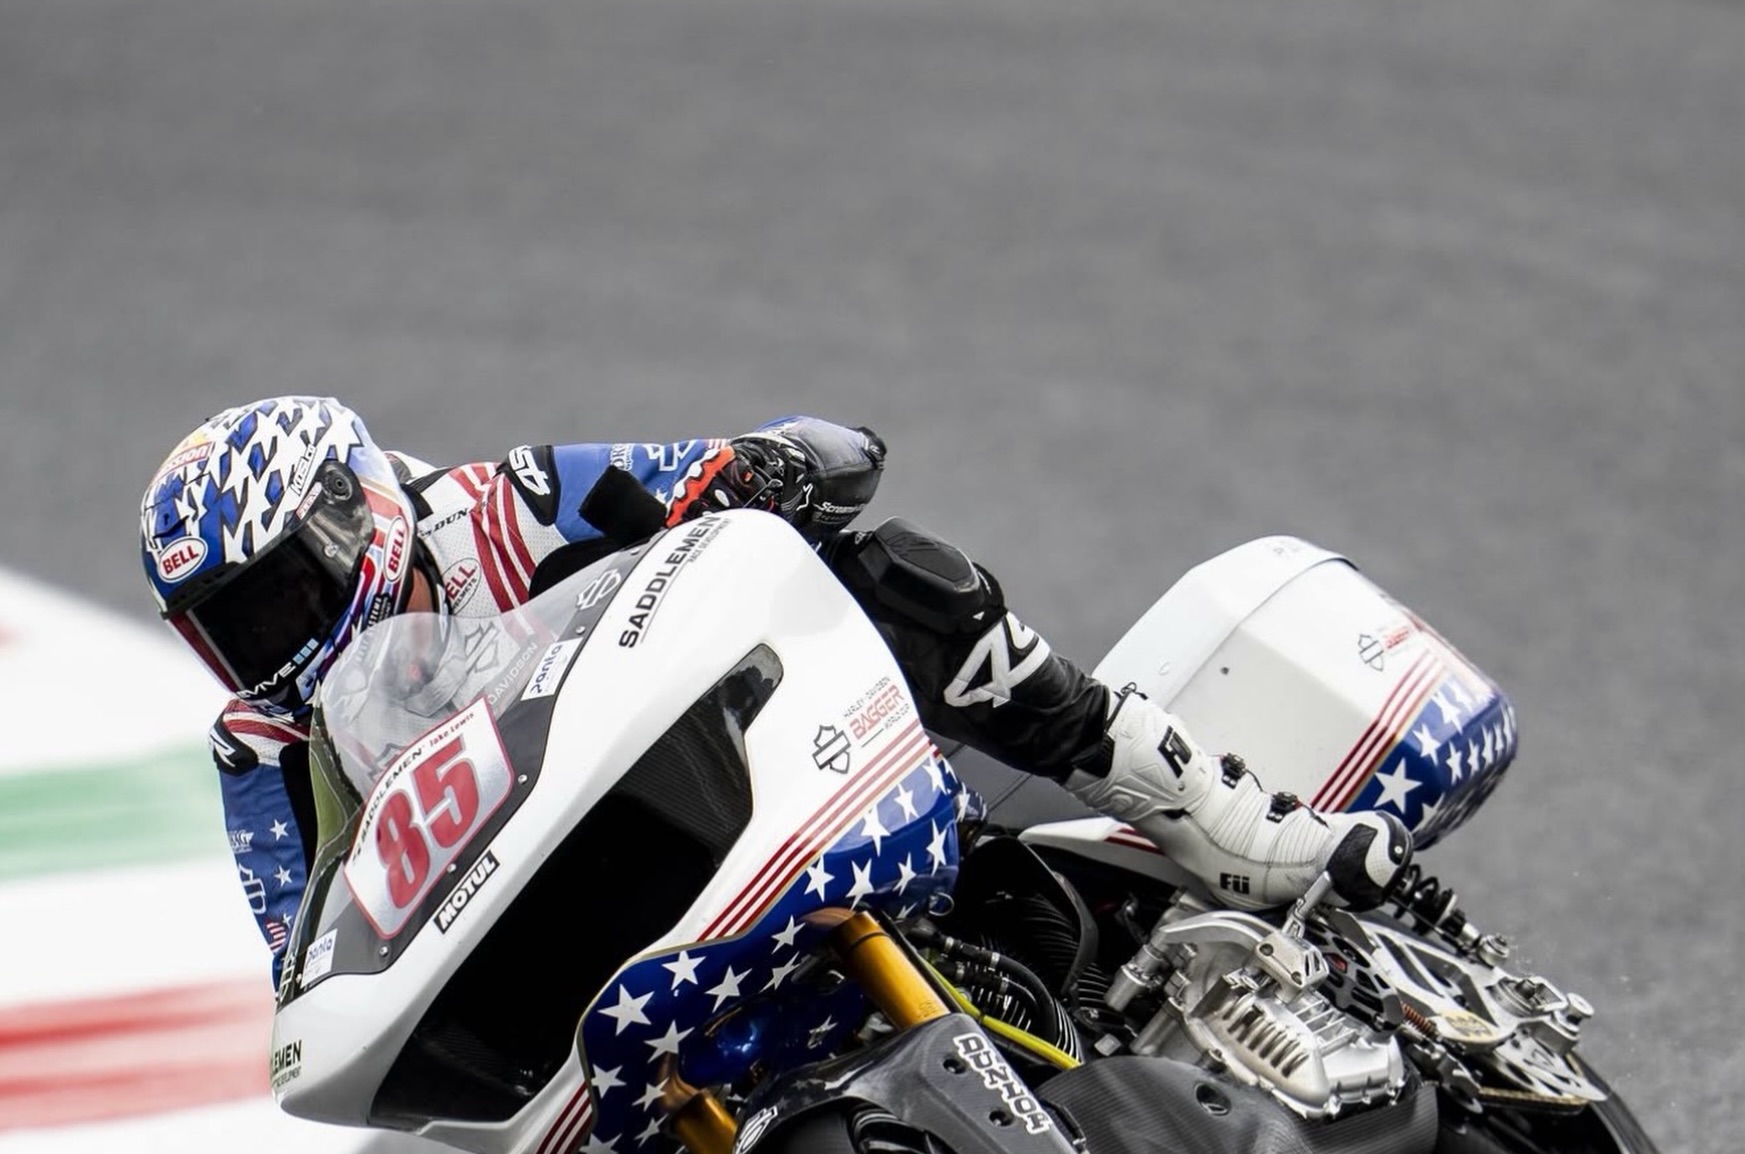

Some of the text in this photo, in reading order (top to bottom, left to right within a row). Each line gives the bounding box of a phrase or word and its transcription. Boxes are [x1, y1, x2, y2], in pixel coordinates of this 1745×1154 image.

[162, 545, 200, 575] BELL
[387, 529, 405, 574] BELL
[445, 565, 475, 600] ELL
[618, 515, 721, 649] SADDLEMEN
[849, 684, 905, 740] BAGGER
[376, 734, 480, 910] 85
[438, 856, 497, 930] MOTUL
[953, 1033, 1050, 1134] DUNLOP
